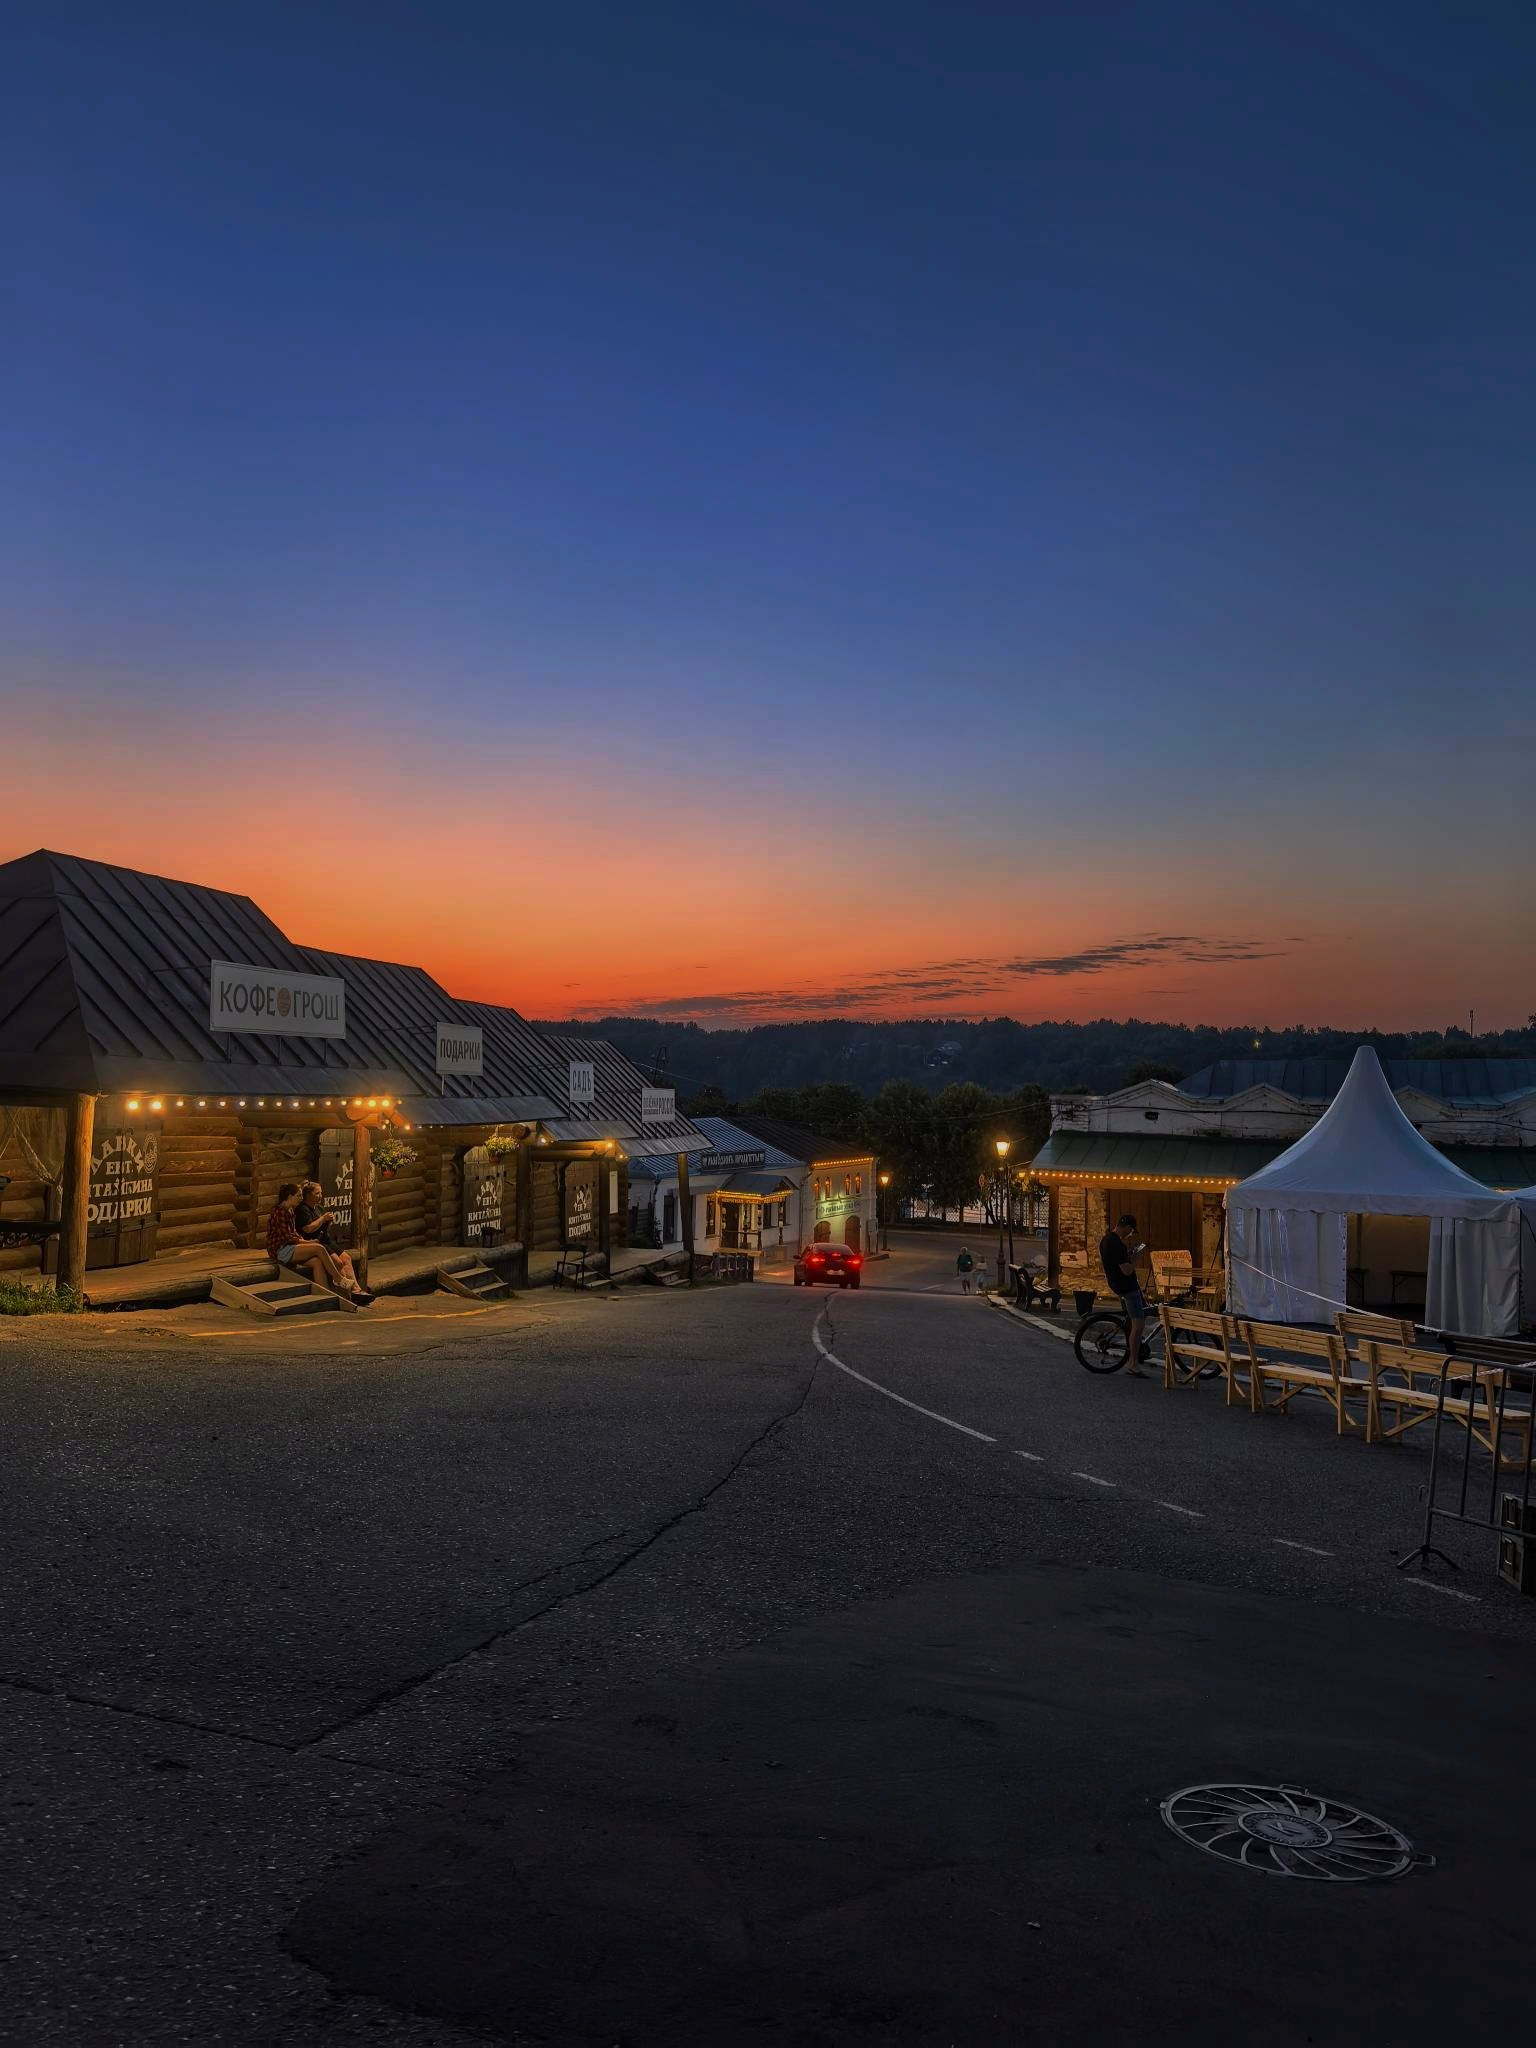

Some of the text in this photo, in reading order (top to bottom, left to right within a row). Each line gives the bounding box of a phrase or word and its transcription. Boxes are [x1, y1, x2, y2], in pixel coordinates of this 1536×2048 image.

[220, 981, 338, 1020] КОФЕ ГРОШ
[440, 1038, 480, 1063] ПОДАРКИ
[573, 1070, 591, 1094] САДЪ
[87, 1197, 153, 1224] ОДАРКИ
